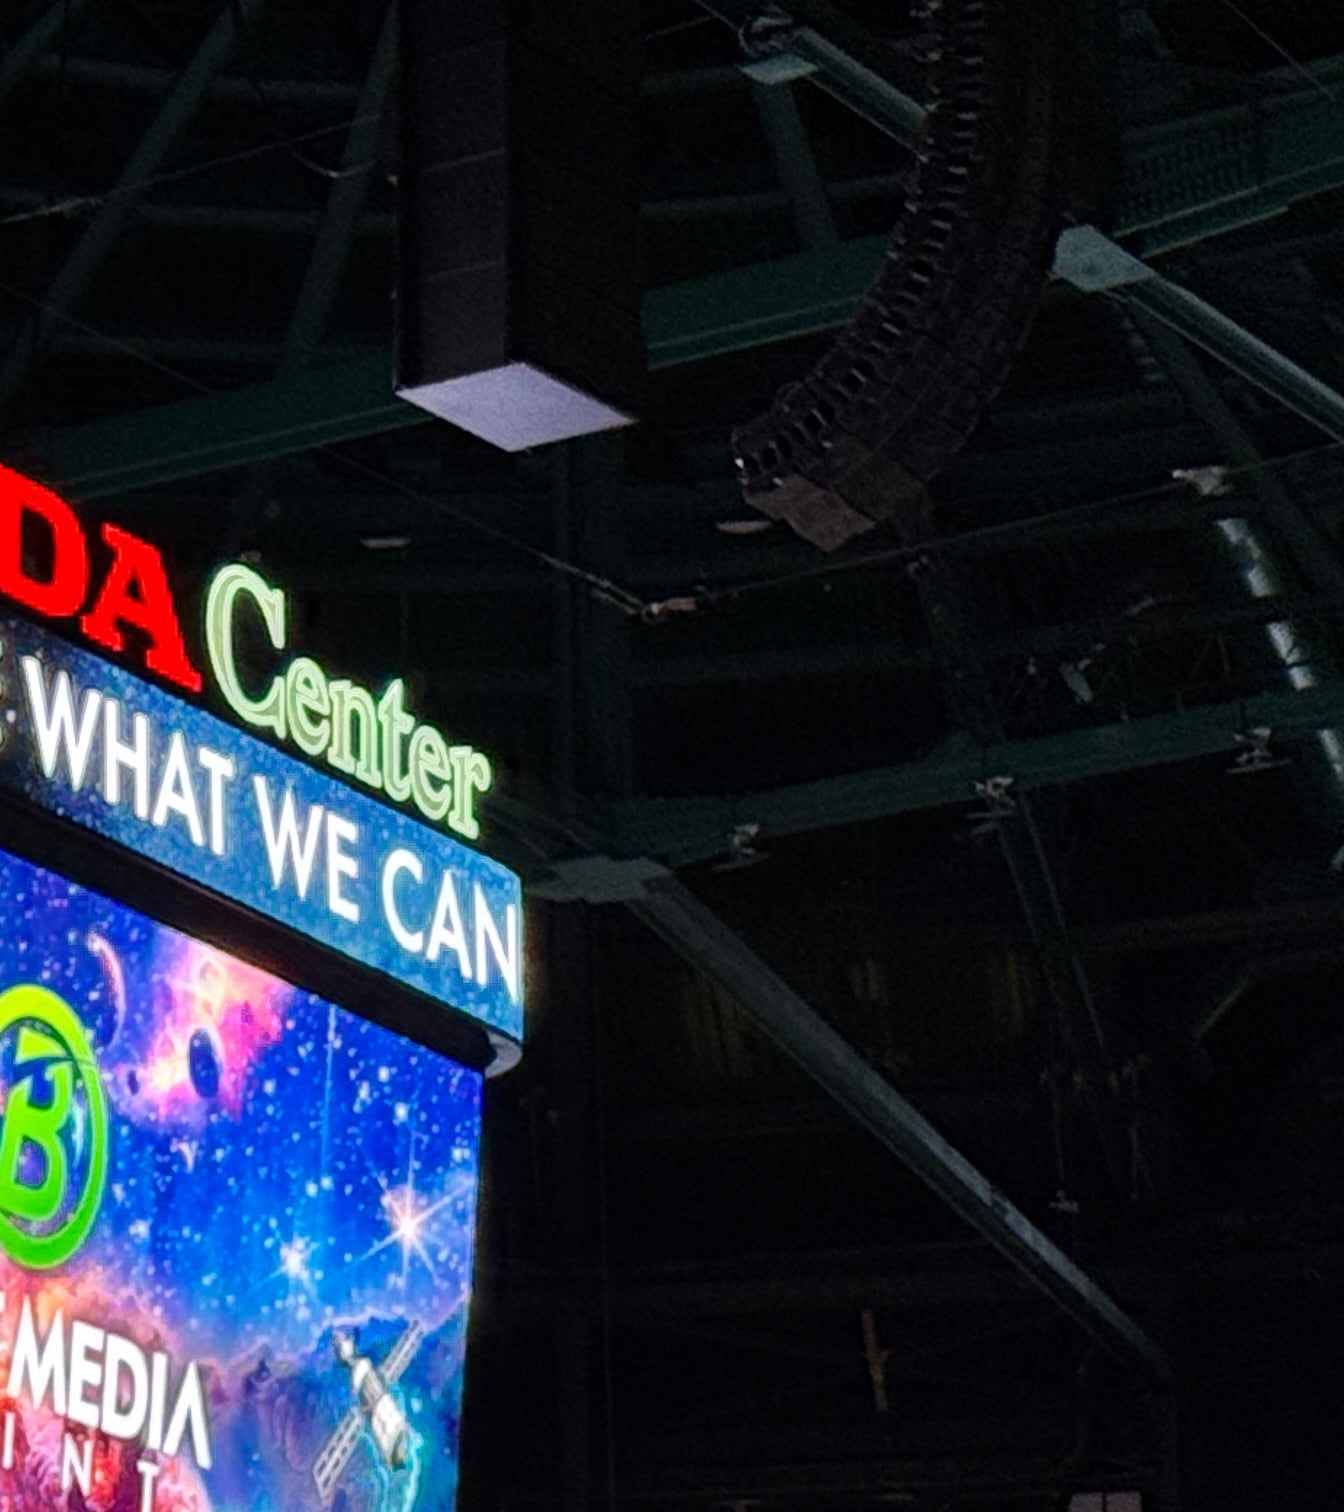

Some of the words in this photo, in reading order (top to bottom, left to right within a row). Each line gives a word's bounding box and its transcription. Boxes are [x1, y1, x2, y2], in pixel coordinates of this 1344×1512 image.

[23, 655, 234, 856] WHAT
[254, 774, 360, 922] WE
[382, 849, 518, 1004] CAN
[208, 562, 492, 840] Center
[8, 1303, 213, 1470] MEDIA
